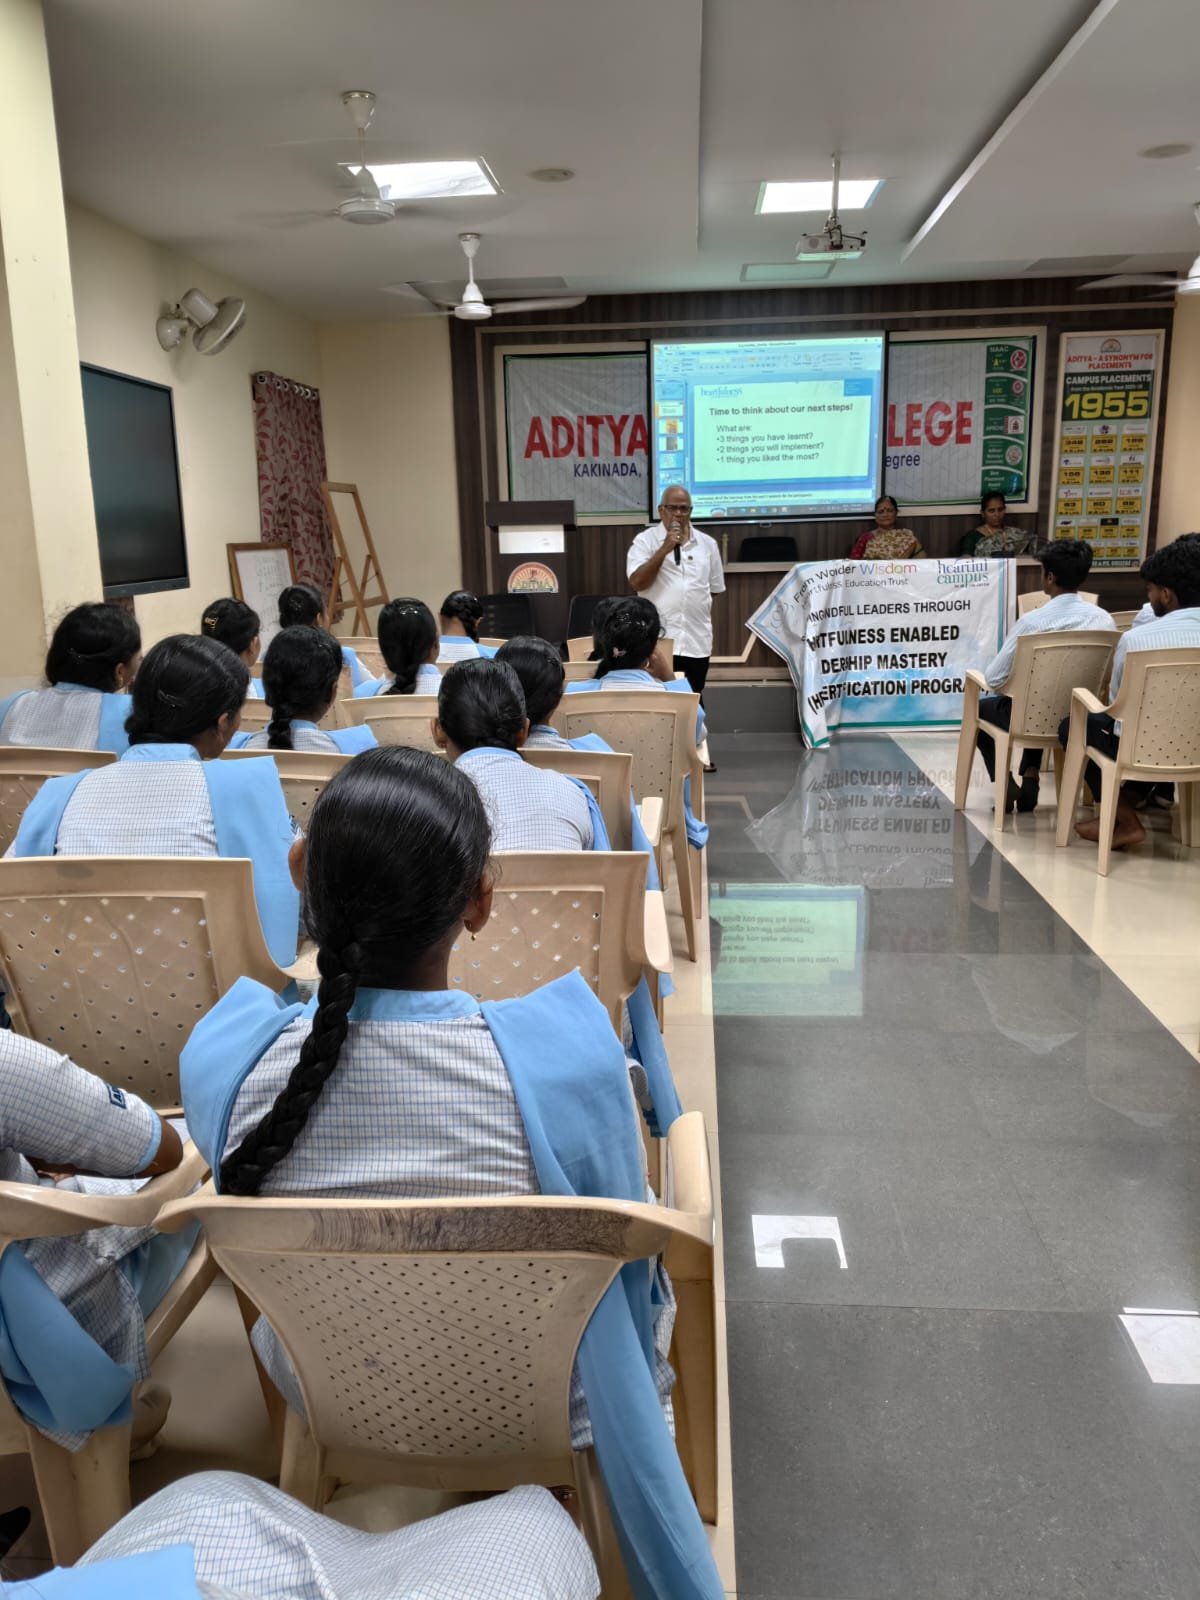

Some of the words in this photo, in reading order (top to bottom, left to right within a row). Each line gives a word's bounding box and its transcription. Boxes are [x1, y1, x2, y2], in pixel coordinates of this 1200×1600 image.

[1066, 376, 1100, 385] CAMPUS
[1100, 374, 1152, 383] PLACEMENTS
[710, 408, 729, 416] Time
[742, 406, 763, 415] think
[764, 405, 789, 414] about
[807, 404, 825, 412] next
[827, 403, 853, 412] steps!
[1064, 390, 1149, 420] 1955
[888, 400, 973, 447] LEGE
[524, 414, 648, 458] ADITYA
[726, 435, 749, 443] things
[726, 446, 749, 454] things
[781, 442, 824, 452] implement?
[726, 456, 745, 464] thing
[886, 454, 920, 470] egree
[574, 463, 641, 478] KAKINADA,
[860, 563, 917, 576] Wisdom
[937, 573, 989, 588] campus
[857, 603, 910, 615] LEADERS
[914, 600, 970, 613] THROUGH
[890, 625, 959, 642] ENABLED
[877, 652, 948, 670] MASTERY
